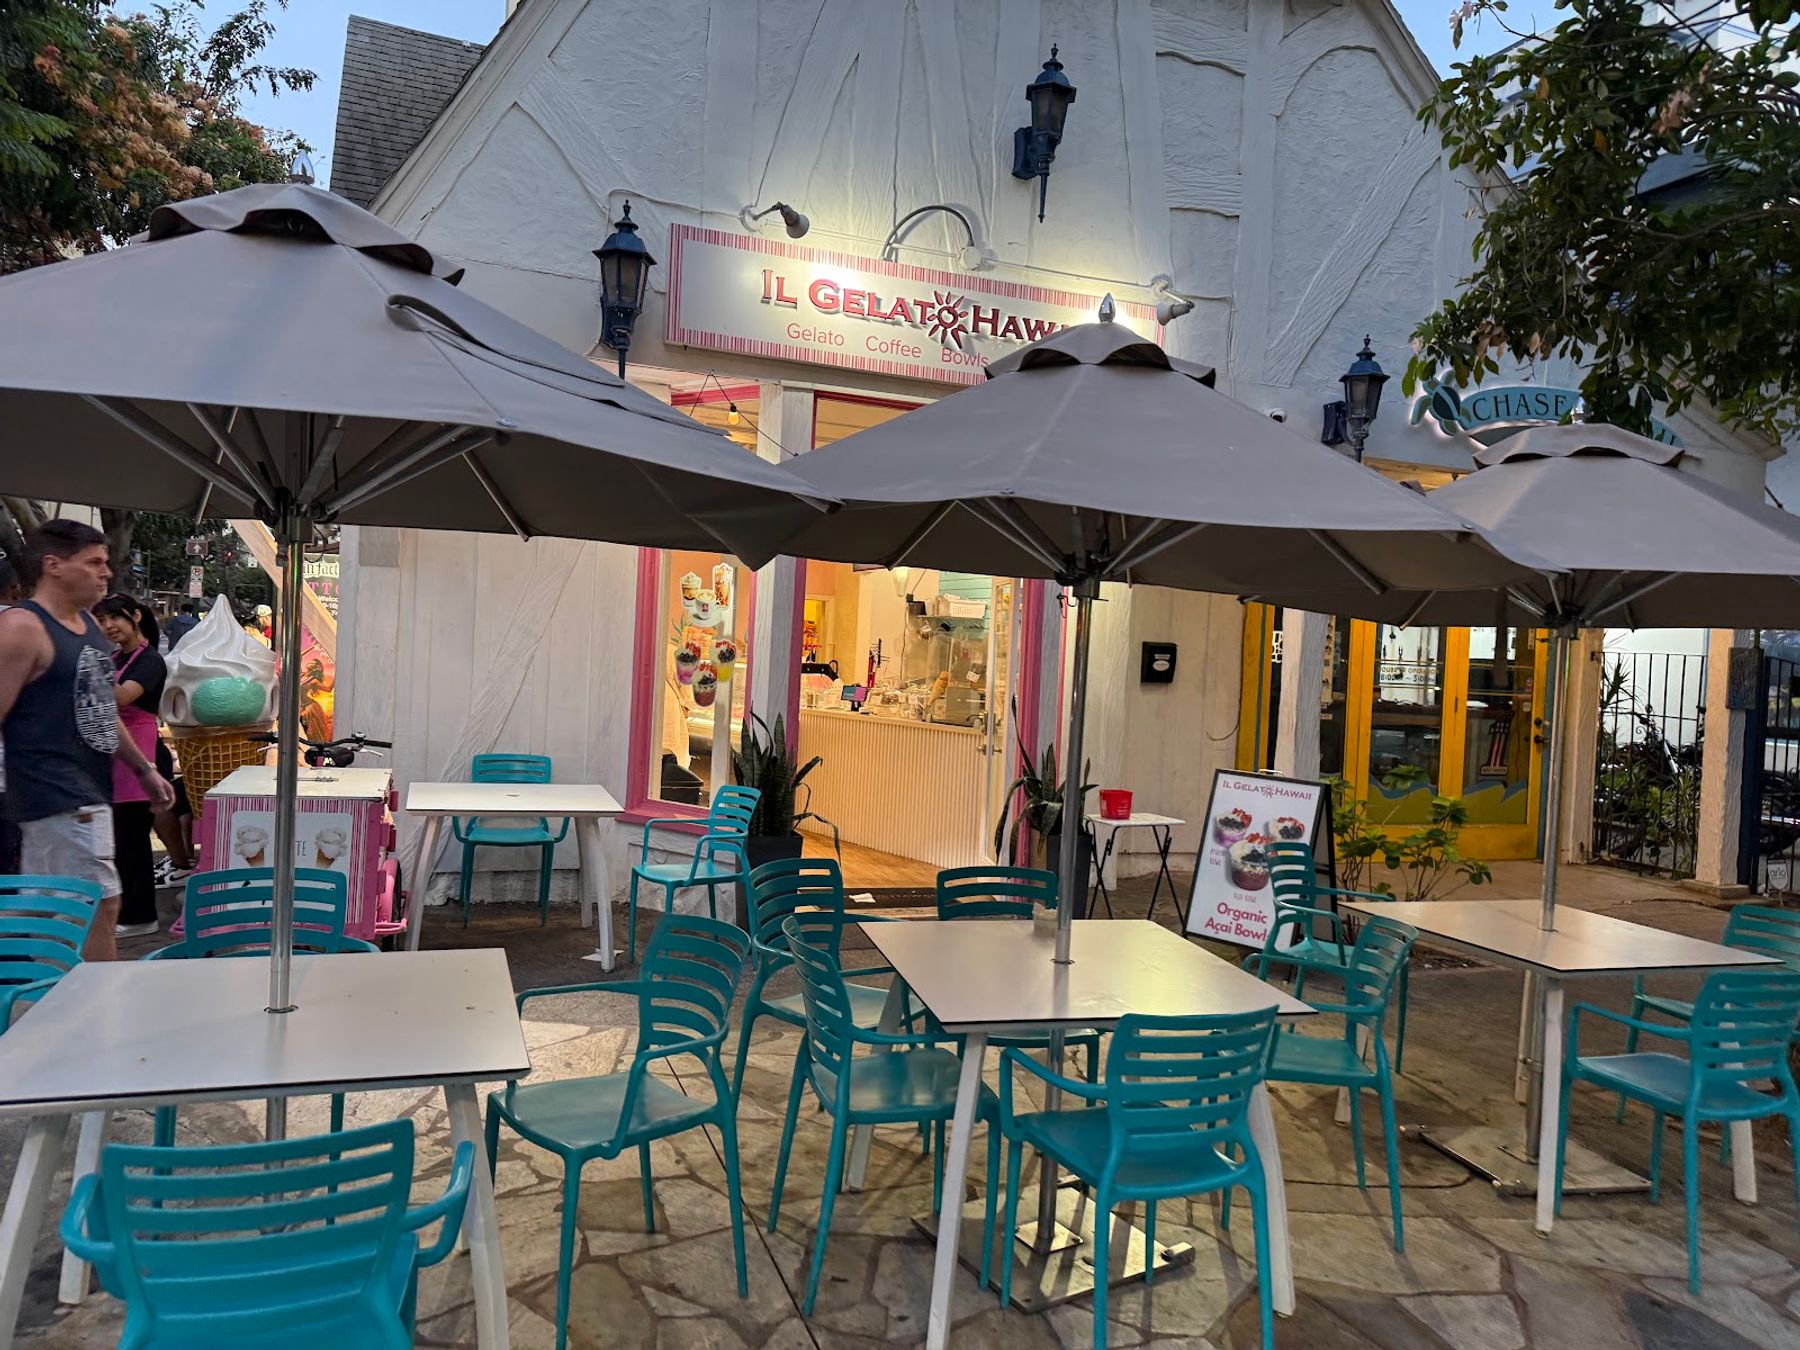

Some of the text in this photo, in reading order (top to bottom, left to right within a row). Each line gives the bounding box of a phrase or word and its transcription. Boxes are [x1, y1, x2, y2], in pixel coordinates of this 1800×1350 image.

[971, 304, 1067, 342] HAW
[786, 322, 989, 368] Gelato Coffee Bowls
[1222, 779, 1312, 800] IL GELATO HAWAII
[1216, 902, 1268, 925] Organic
[1204, 917, 1268, 941] Açai Bowl
